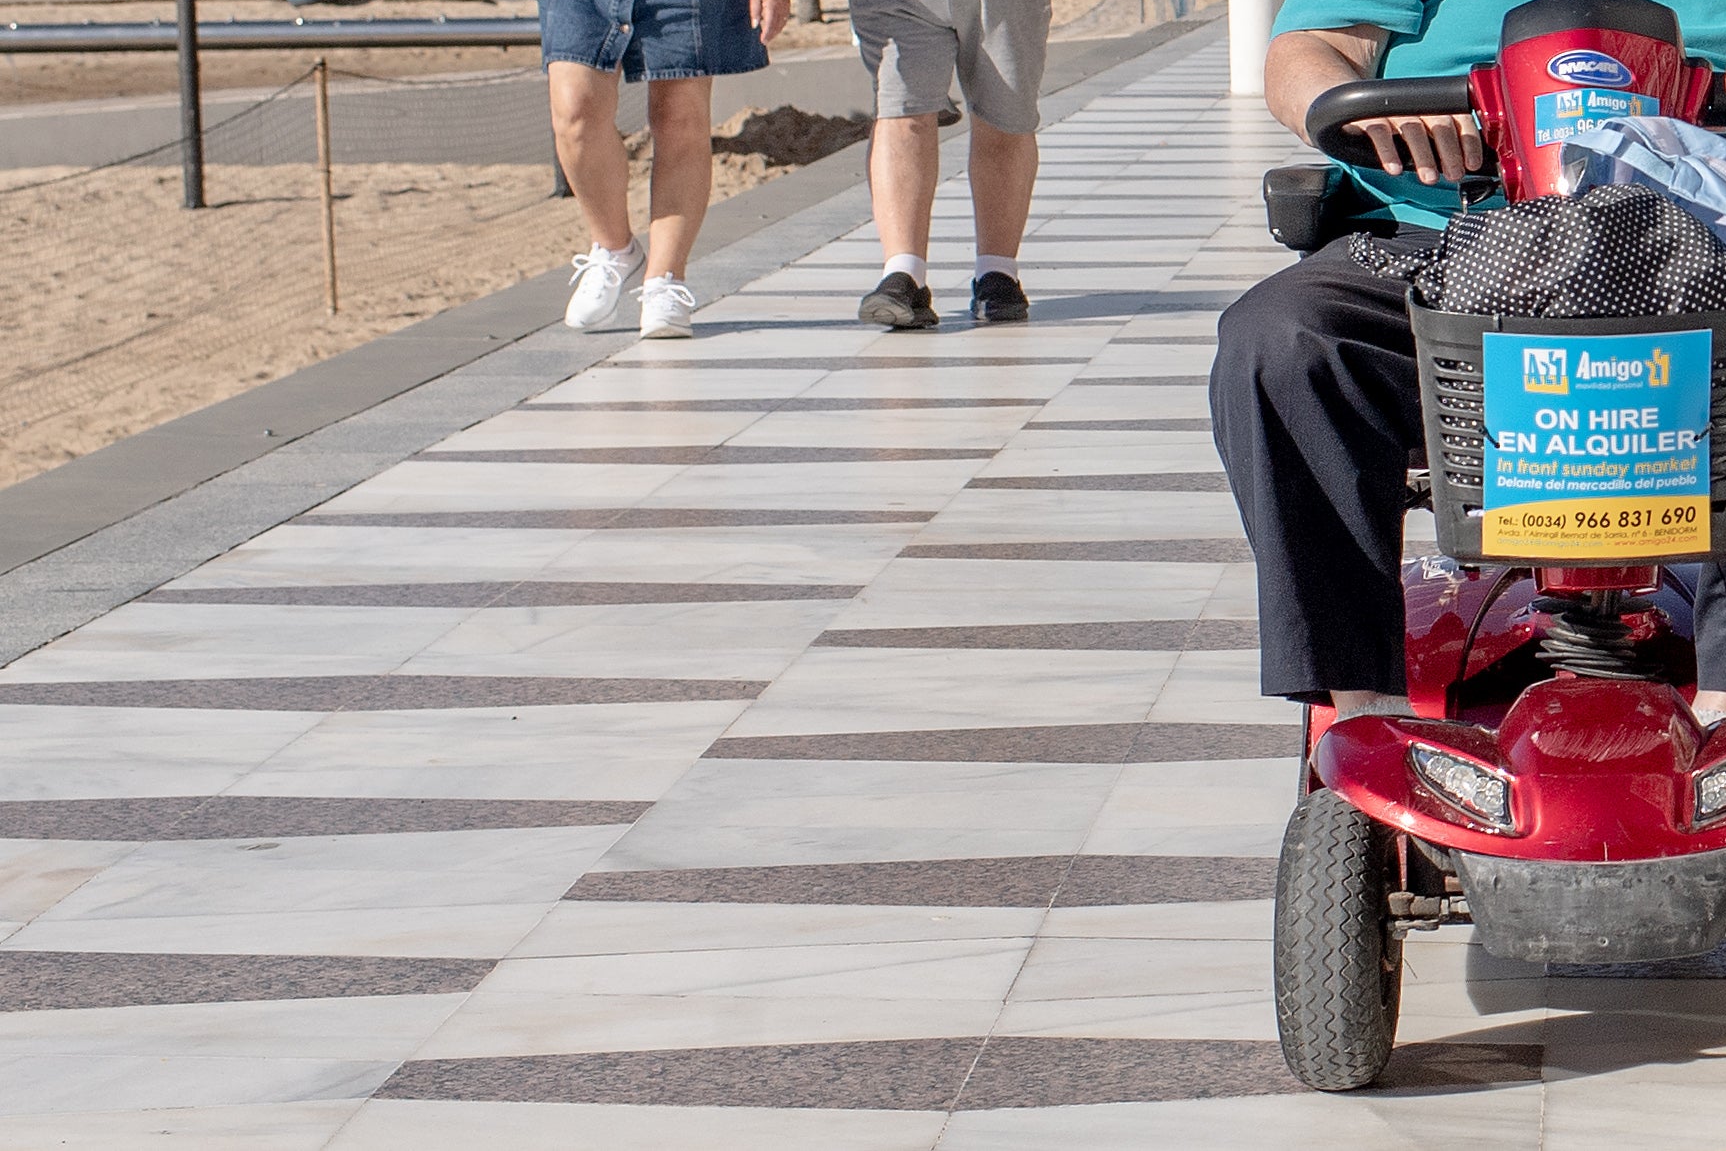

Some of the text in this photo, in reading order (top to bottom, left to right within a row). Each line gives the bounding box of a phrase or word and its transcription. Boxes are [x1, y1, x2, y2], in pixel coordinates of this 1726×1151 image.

[1588, 91, 1627, 110] Amigo
[1576, 350, 1643, 381] Amigo
[1535, 407, 1659, 430] ON HIRE
[1498, 430, 1697, 456] EN ALQUILER
[1497, 454, 1698, 478] In front sunday market
[1497, 474, 1697, 490] Delante del mercadillo del pueblo
[1498, 506, 1696, 529] Tel.: (0034) 966 831 690
[1654, 527, 1697, 537] BENIDORM
